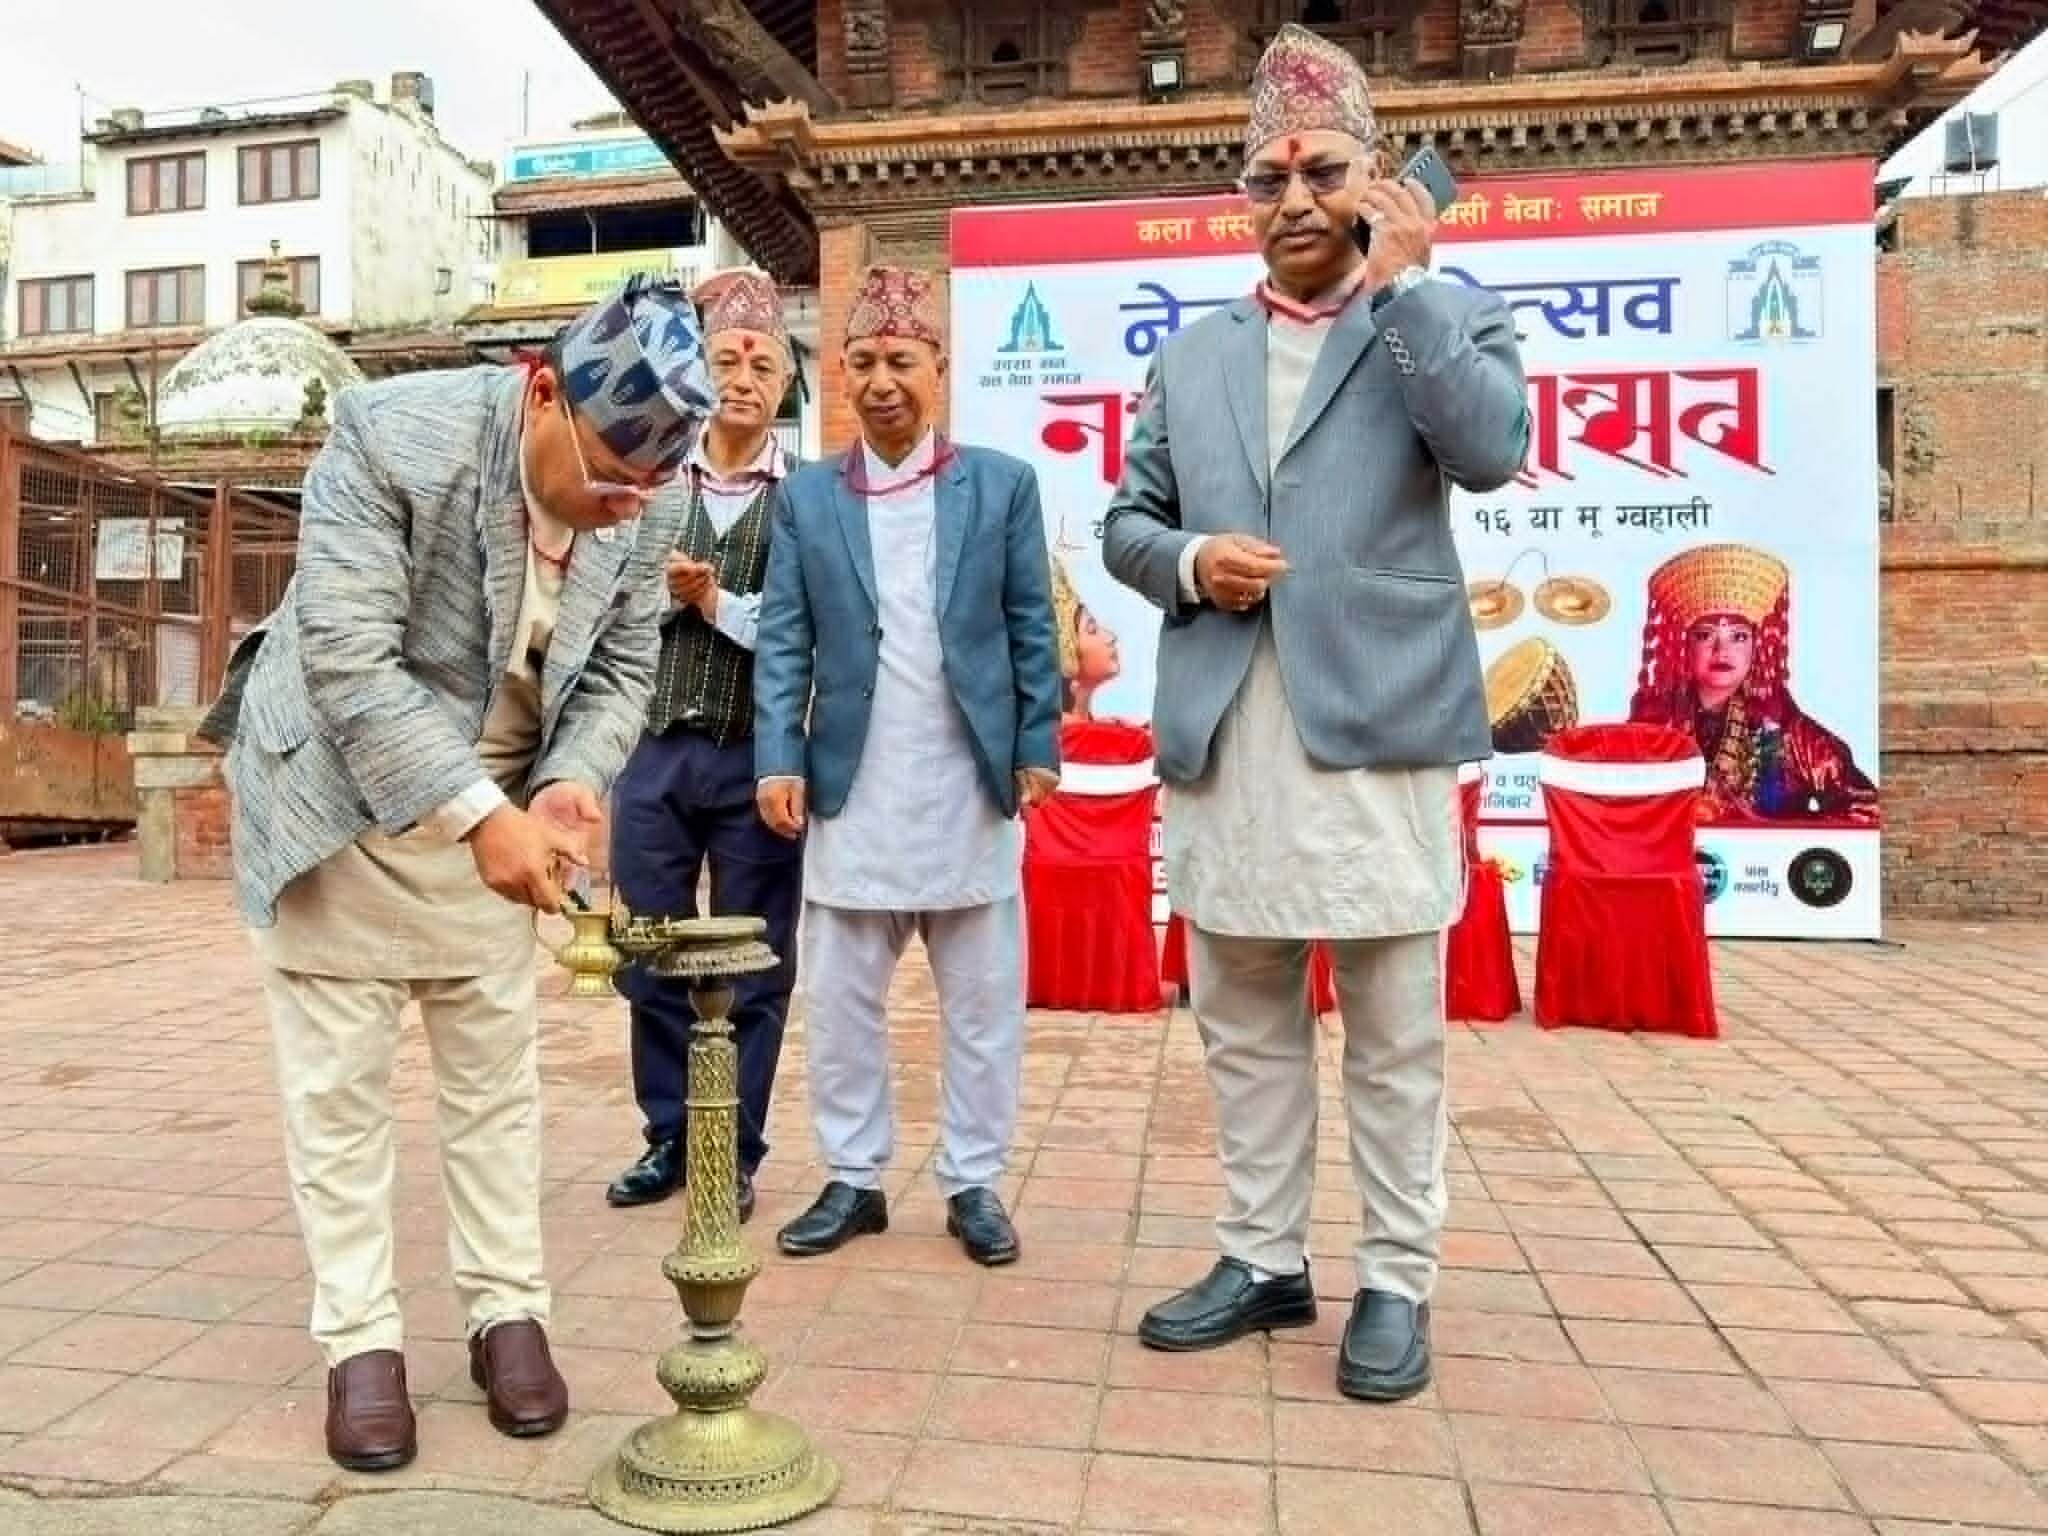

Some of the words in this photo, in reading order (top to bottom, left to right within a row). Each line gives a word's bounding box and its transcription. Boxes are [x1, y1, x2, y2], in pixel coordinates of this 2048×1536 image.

[1135, 217, 1194, 243] कला
[1577, 191, 1664, 223] समाज
[1527, 506, 1563, 530] या
